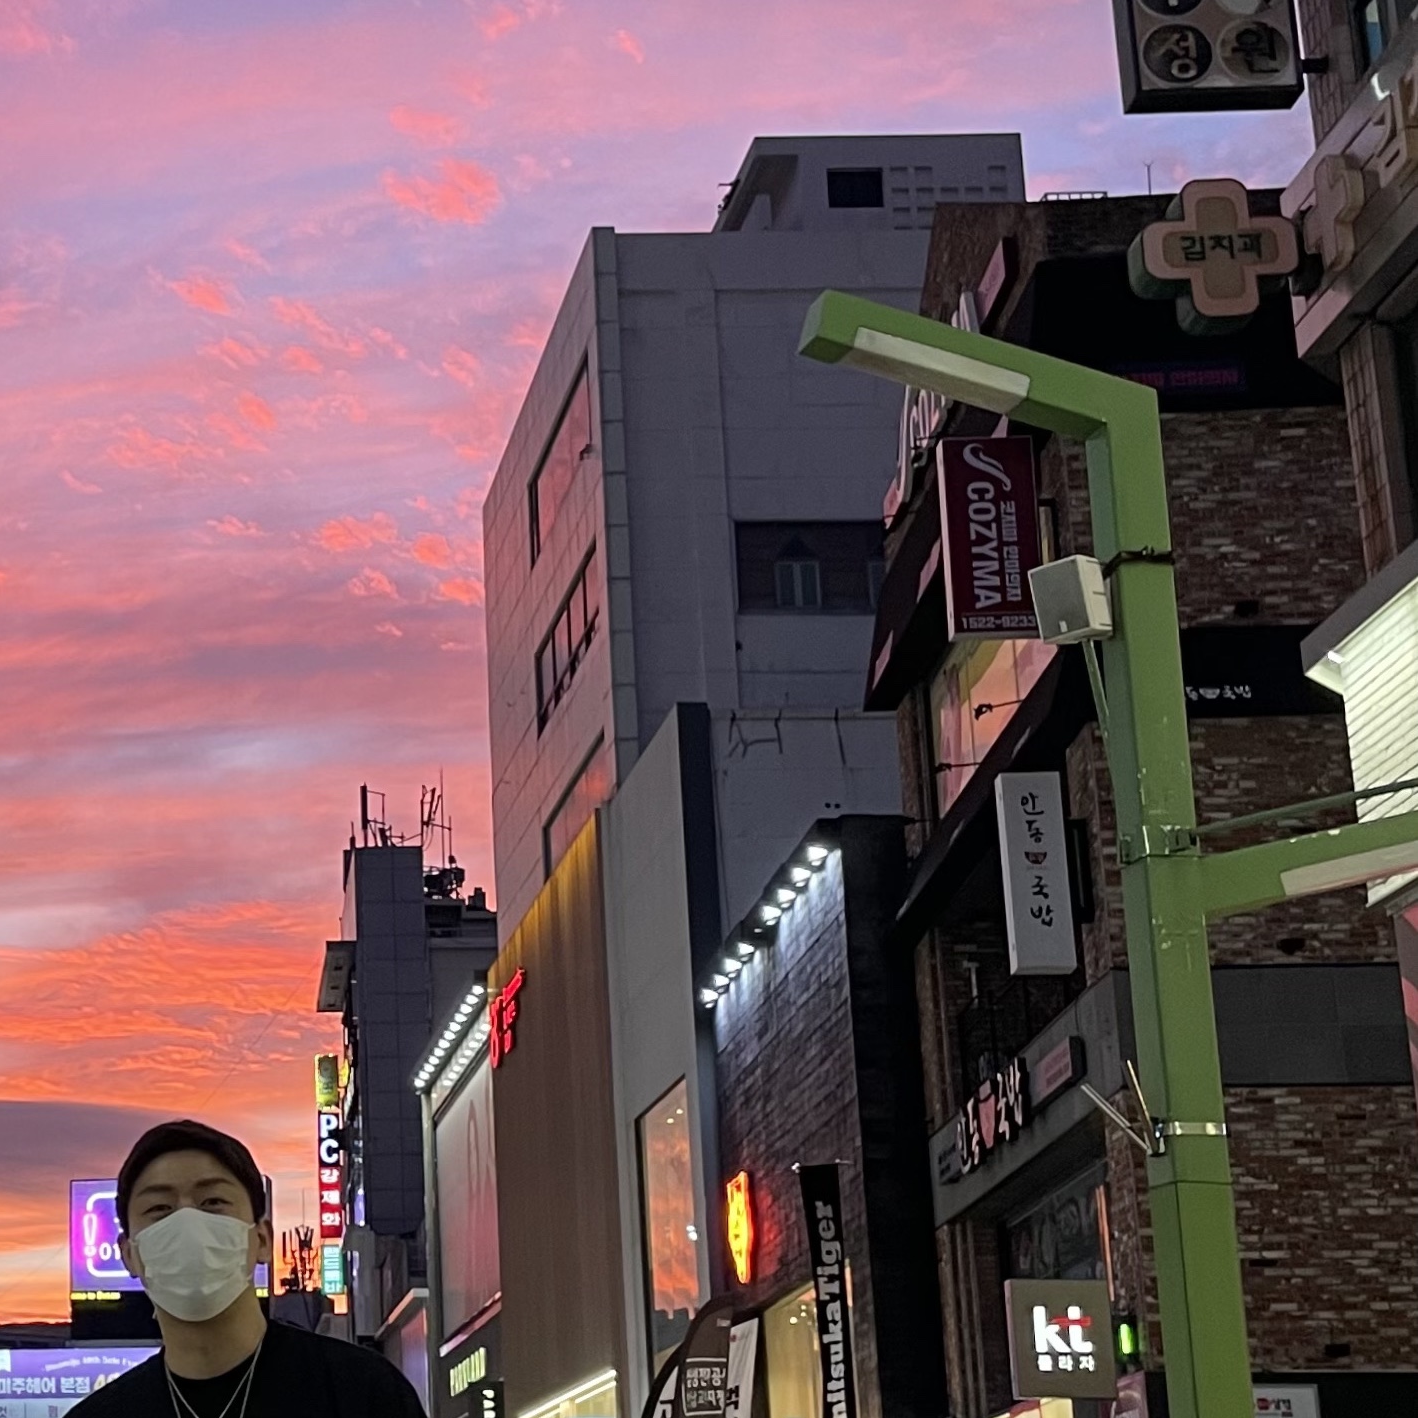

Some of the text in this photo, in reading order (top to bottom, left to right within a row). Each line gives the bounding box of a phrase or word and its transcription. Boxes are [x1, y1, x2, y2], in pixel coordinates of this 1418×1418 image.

[966, 481, 1002, 609] COZYMA
[319, 1114, 339, 1164] PC
[814, 1200, 842, 1301] Tiger
[1033, 1305, 1093, 1354] kt
